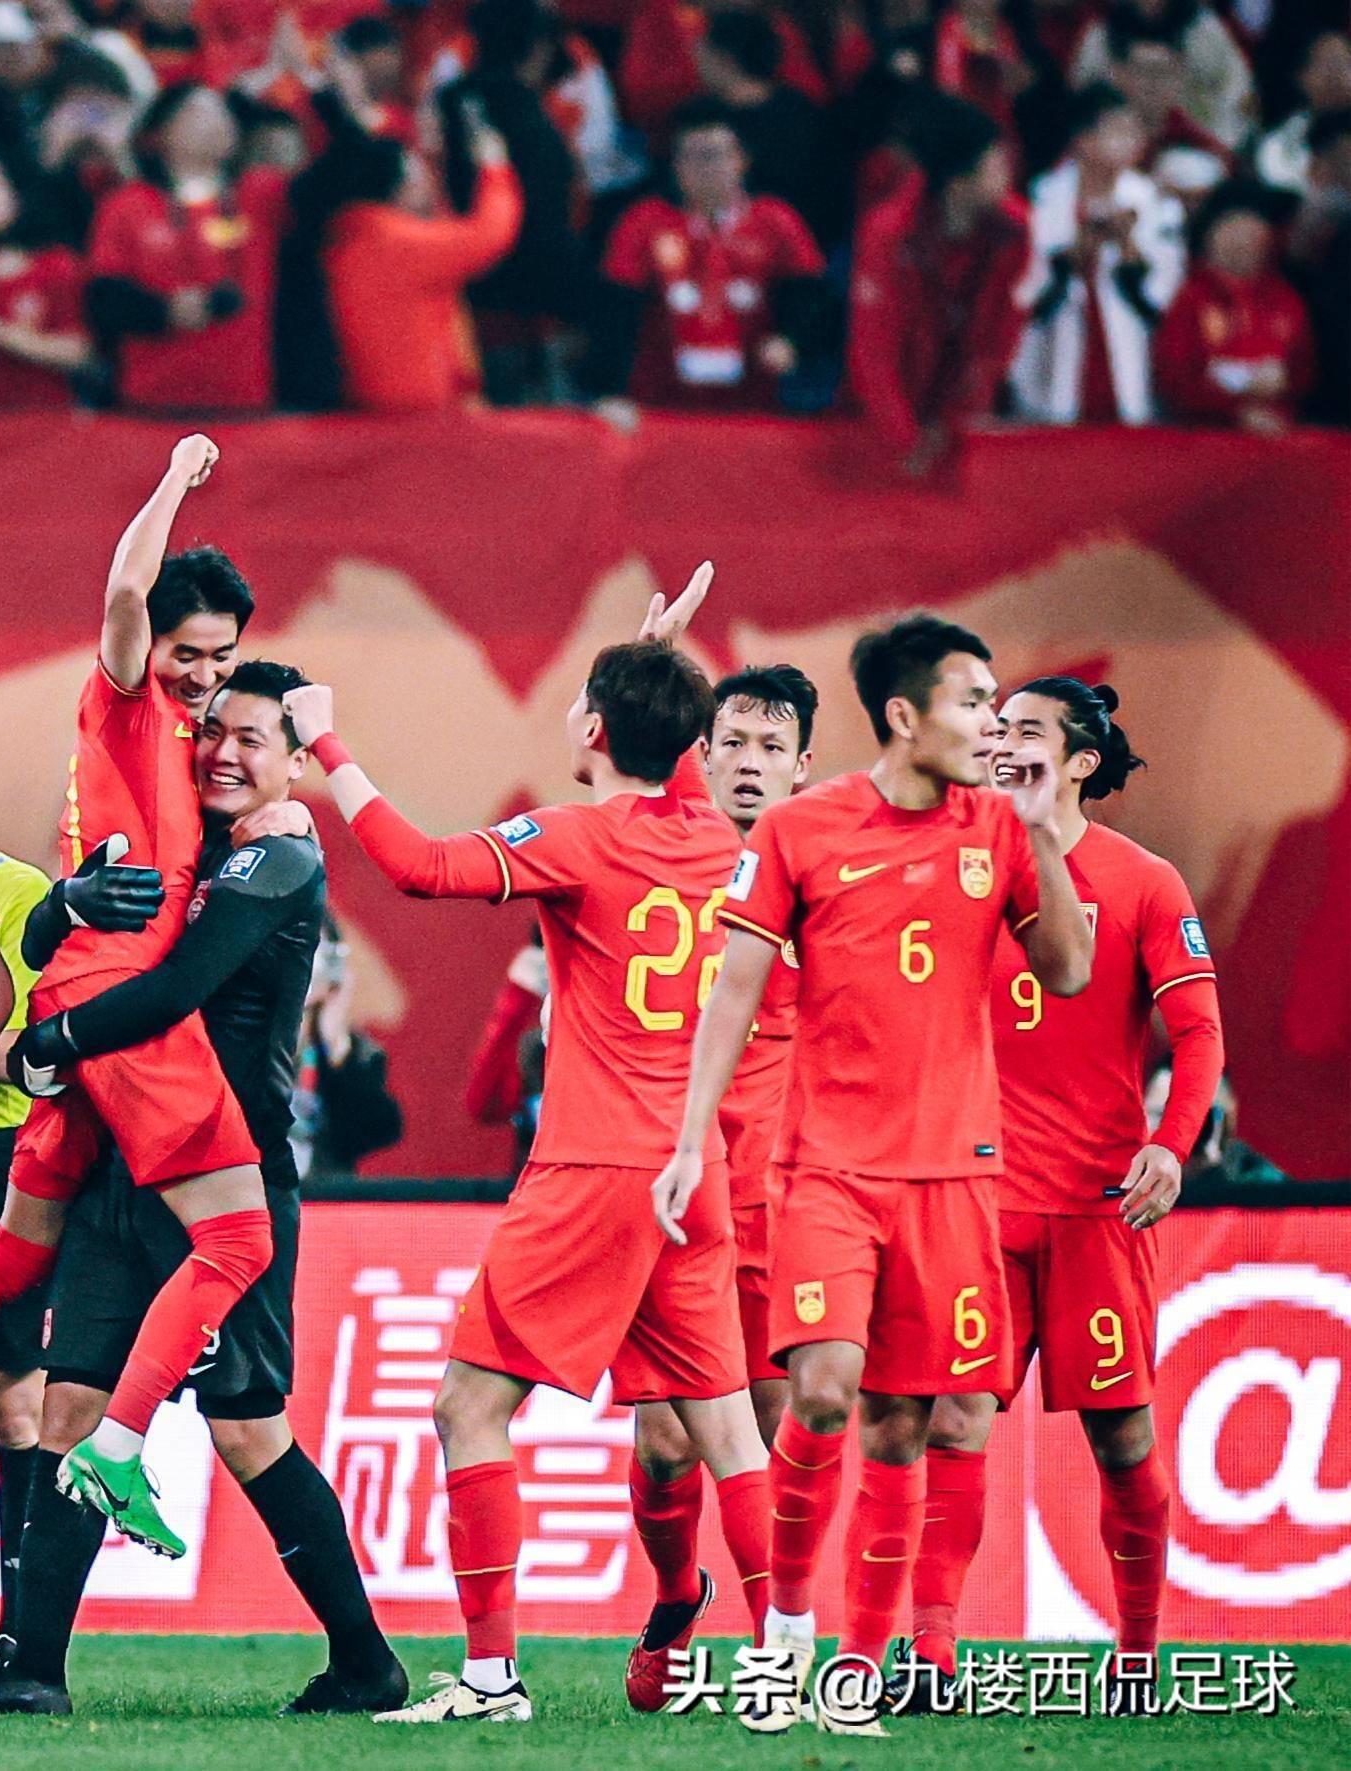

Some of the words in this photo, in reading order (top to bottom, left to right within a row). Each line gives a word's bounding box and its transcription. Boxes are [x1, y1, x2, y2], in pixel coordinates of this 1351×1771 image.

[898, 919, 935, 983] 6
[1010, 971, 1043, 1030] 9
[953, 1286, 988, 1351] 6
[1089, 1307, 1125, 1368] 9
